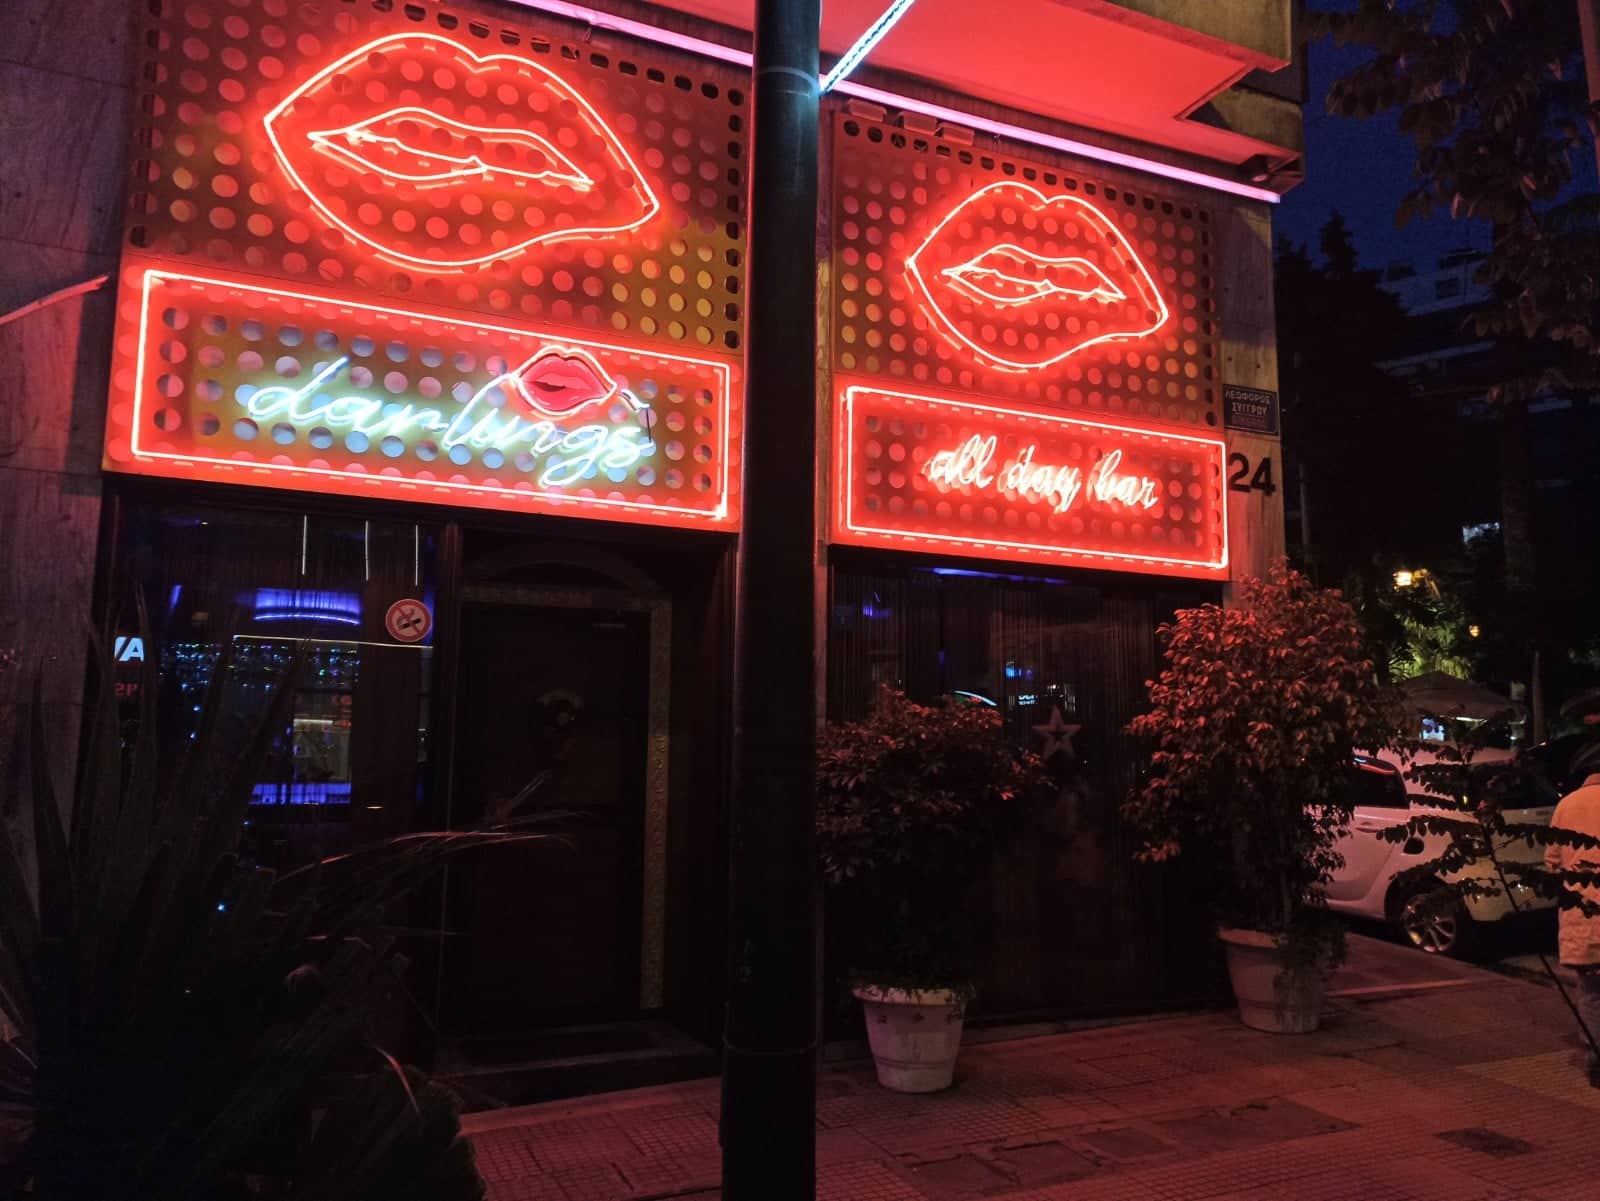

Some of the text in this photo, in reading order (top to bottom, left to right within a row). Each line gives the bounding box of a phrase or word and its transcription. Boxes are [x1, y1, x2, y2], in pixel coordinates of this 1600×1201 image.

[924, 434, 1158, 512] all day bar
[1229, 452, 1276, 496] 24
